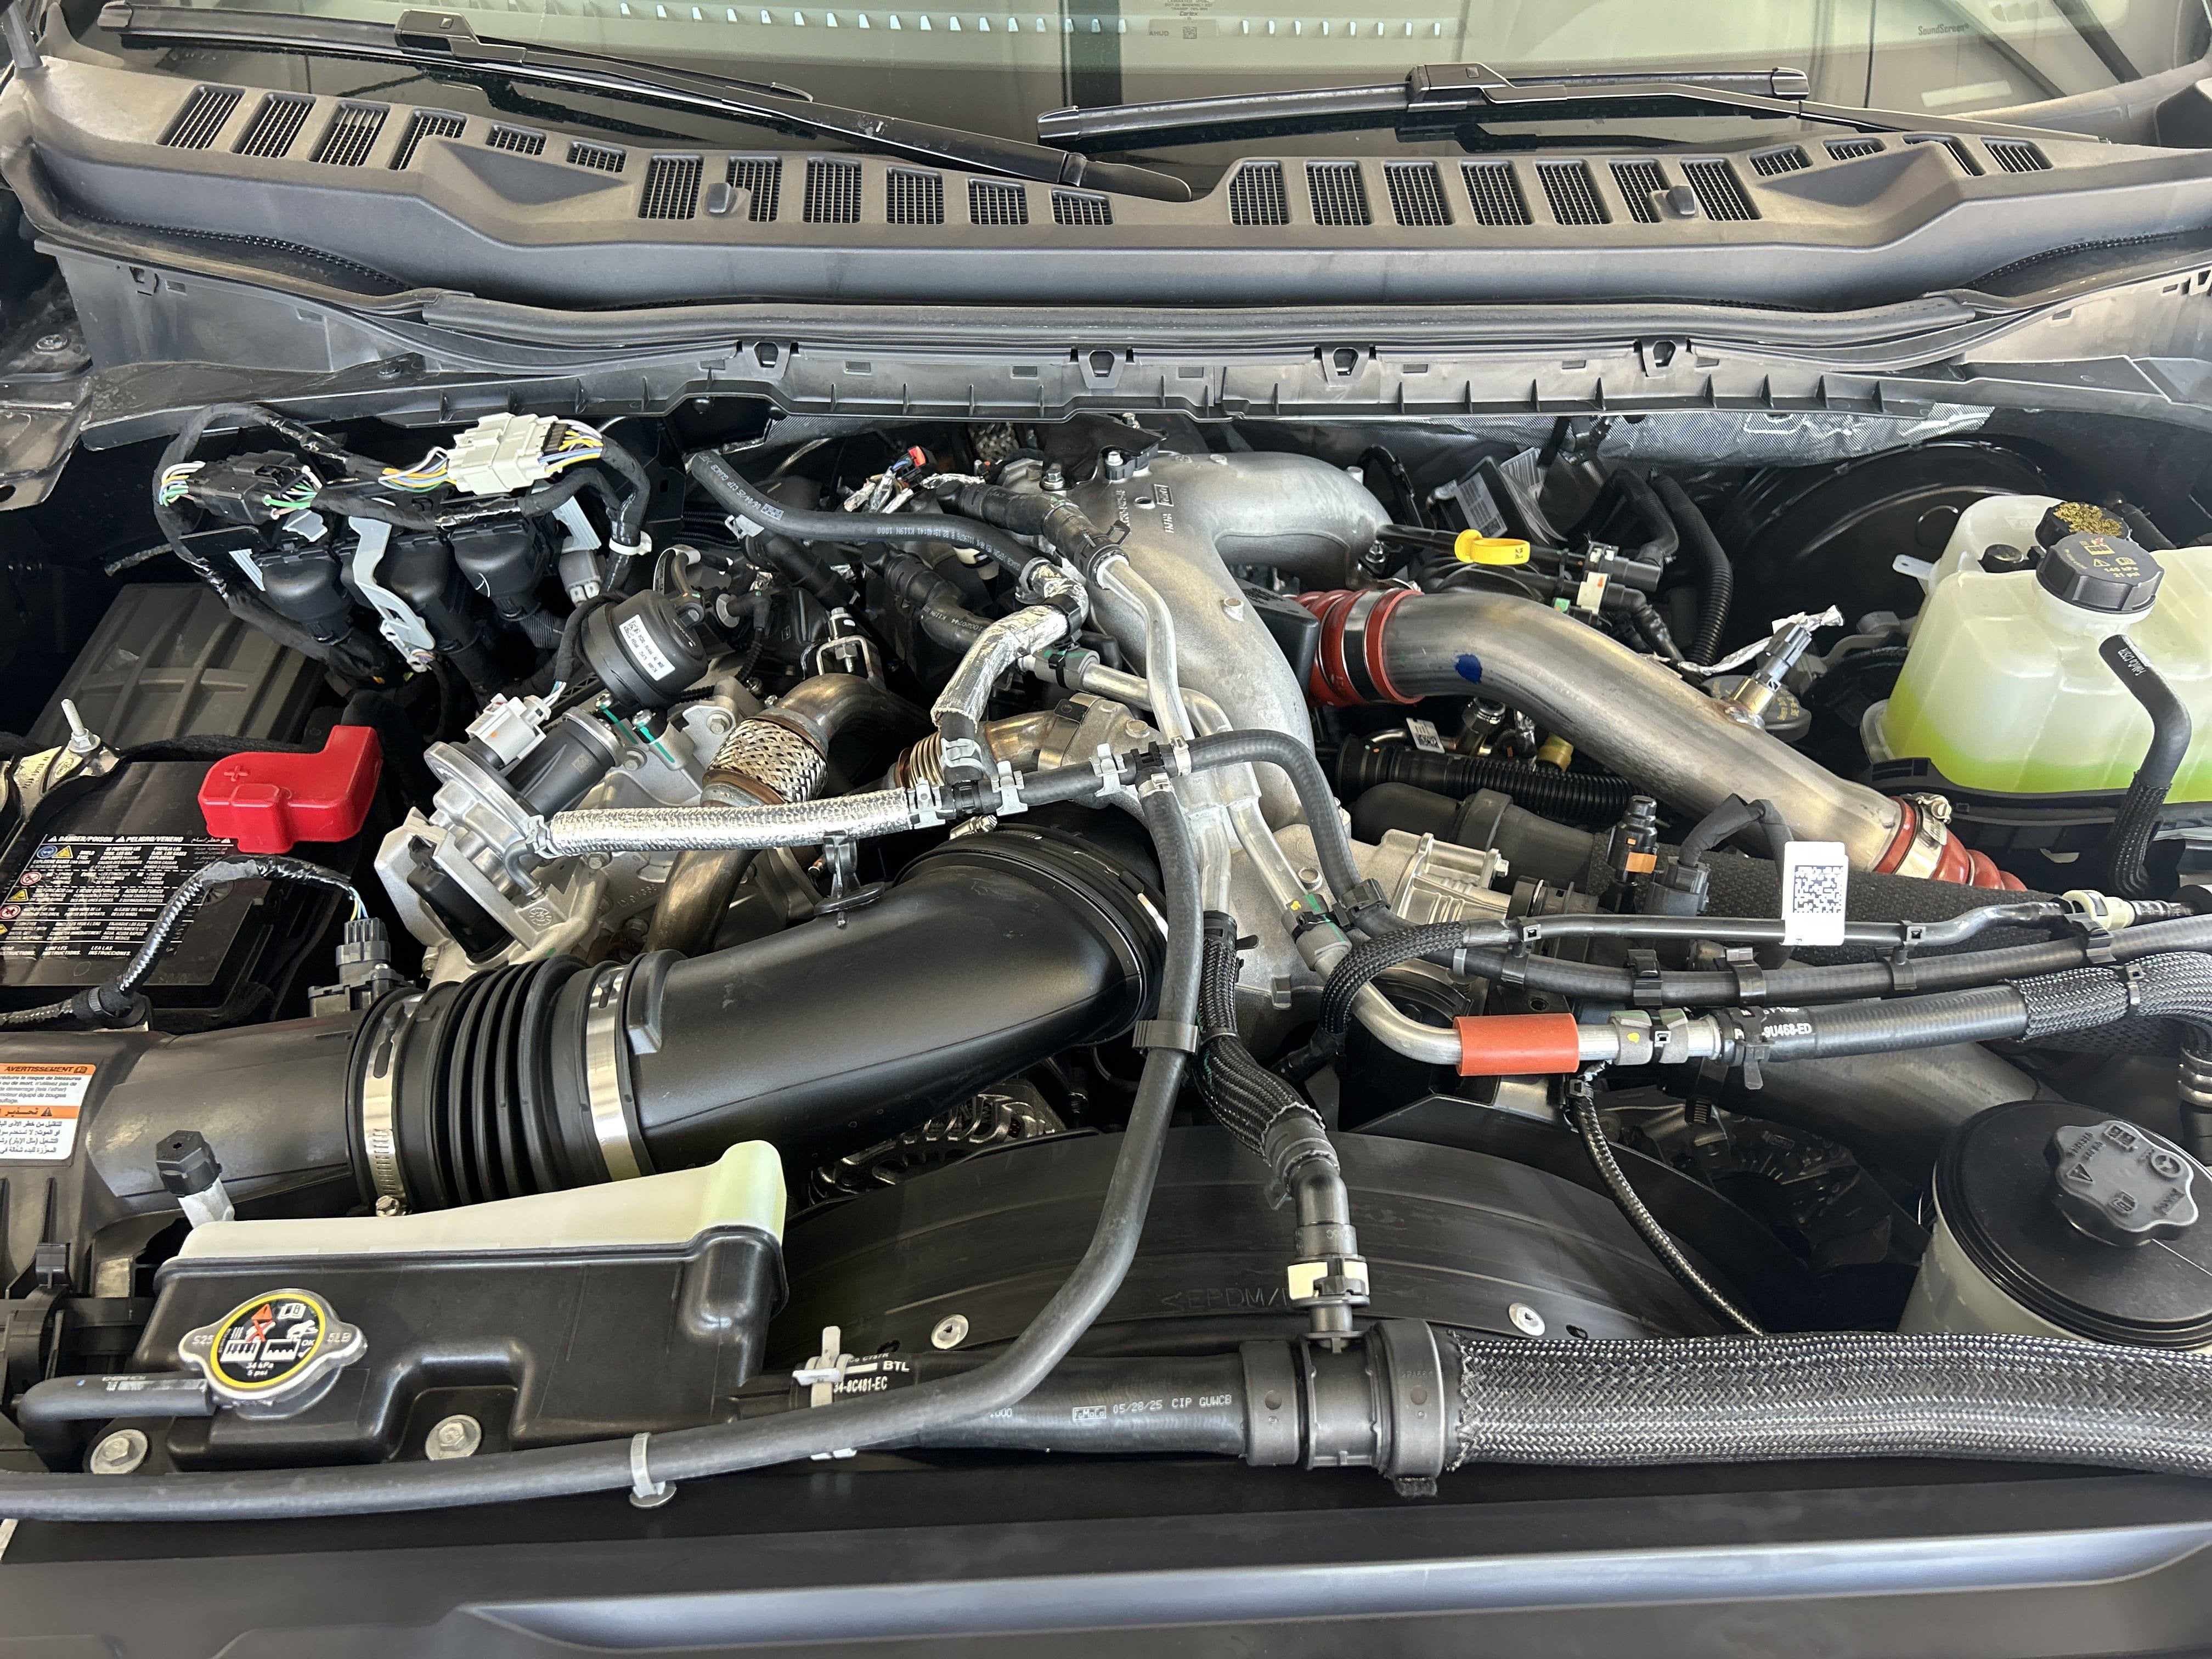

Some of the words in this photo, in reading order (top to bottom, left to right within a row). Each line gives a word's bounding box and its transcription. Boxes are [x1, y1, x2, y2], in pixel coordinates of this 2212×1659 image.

[726, 479, 739, 491] CIP
[878, 526, 893, 535] 1000
[192, 1335, 213, 1345] S25
[326, 1332, 351, 1343] 5LB
[883, 1361, 909, 1372] BTL
[1073, 1406, 1106, 1421] FoMoCo
[1113, 1398, 1163, 1414] 05/28/25
[1171, 1397, 1192, 1409] CIP
[1199, 1394, 1232, 1407] GUWCB
